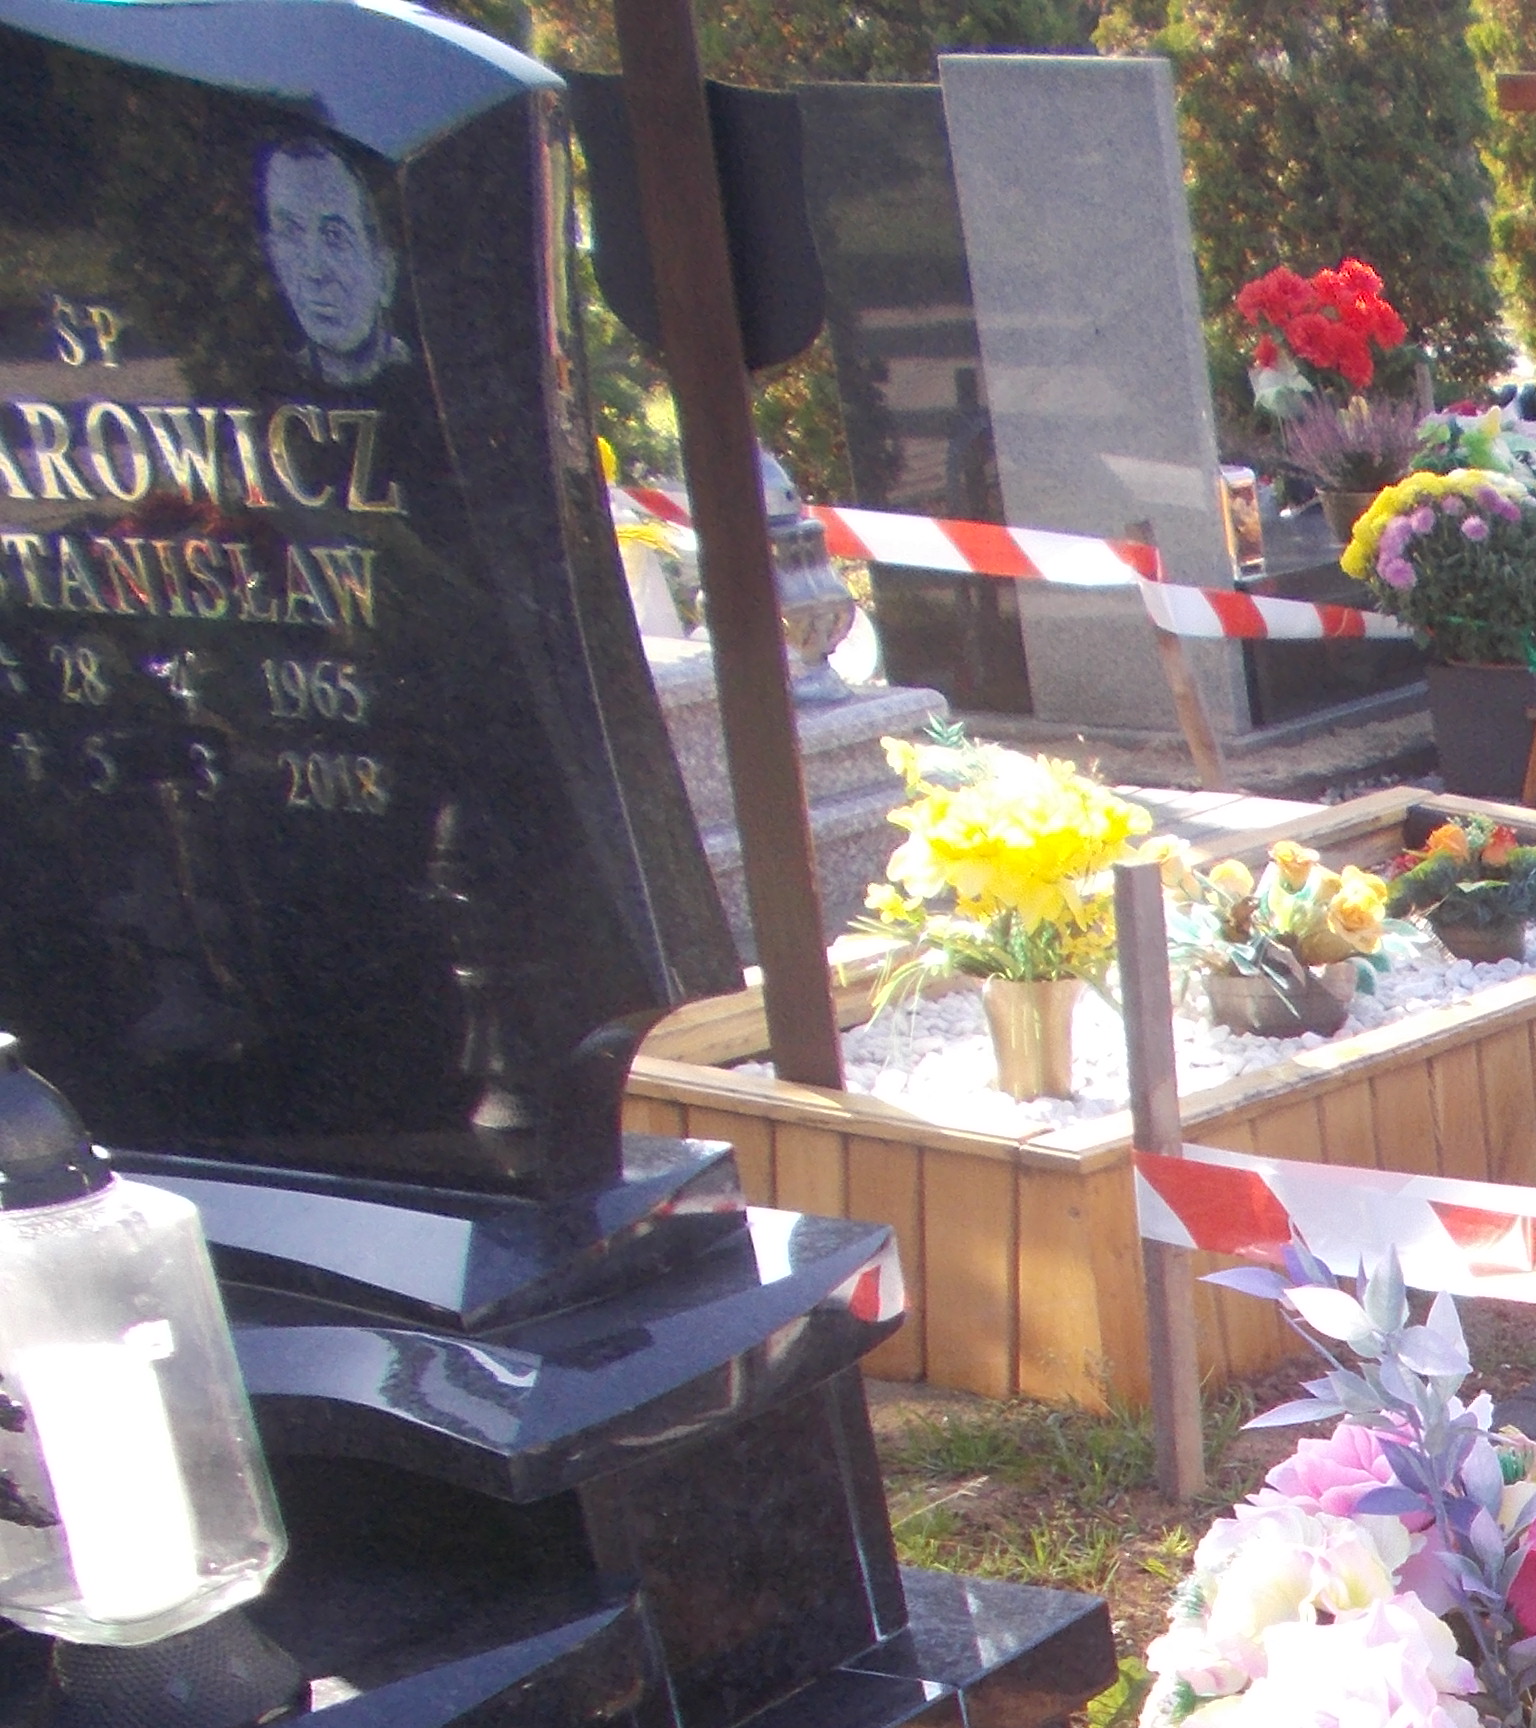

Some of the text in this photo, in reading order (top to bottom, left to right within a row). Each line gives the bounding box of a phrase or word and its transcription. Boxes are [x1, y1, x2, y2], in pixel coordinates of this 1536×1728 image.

[0, 532, 383, 632] TANISŁAW
[261, 658, 367, 723] 1965
[278, 751, 389, 816] 2018
